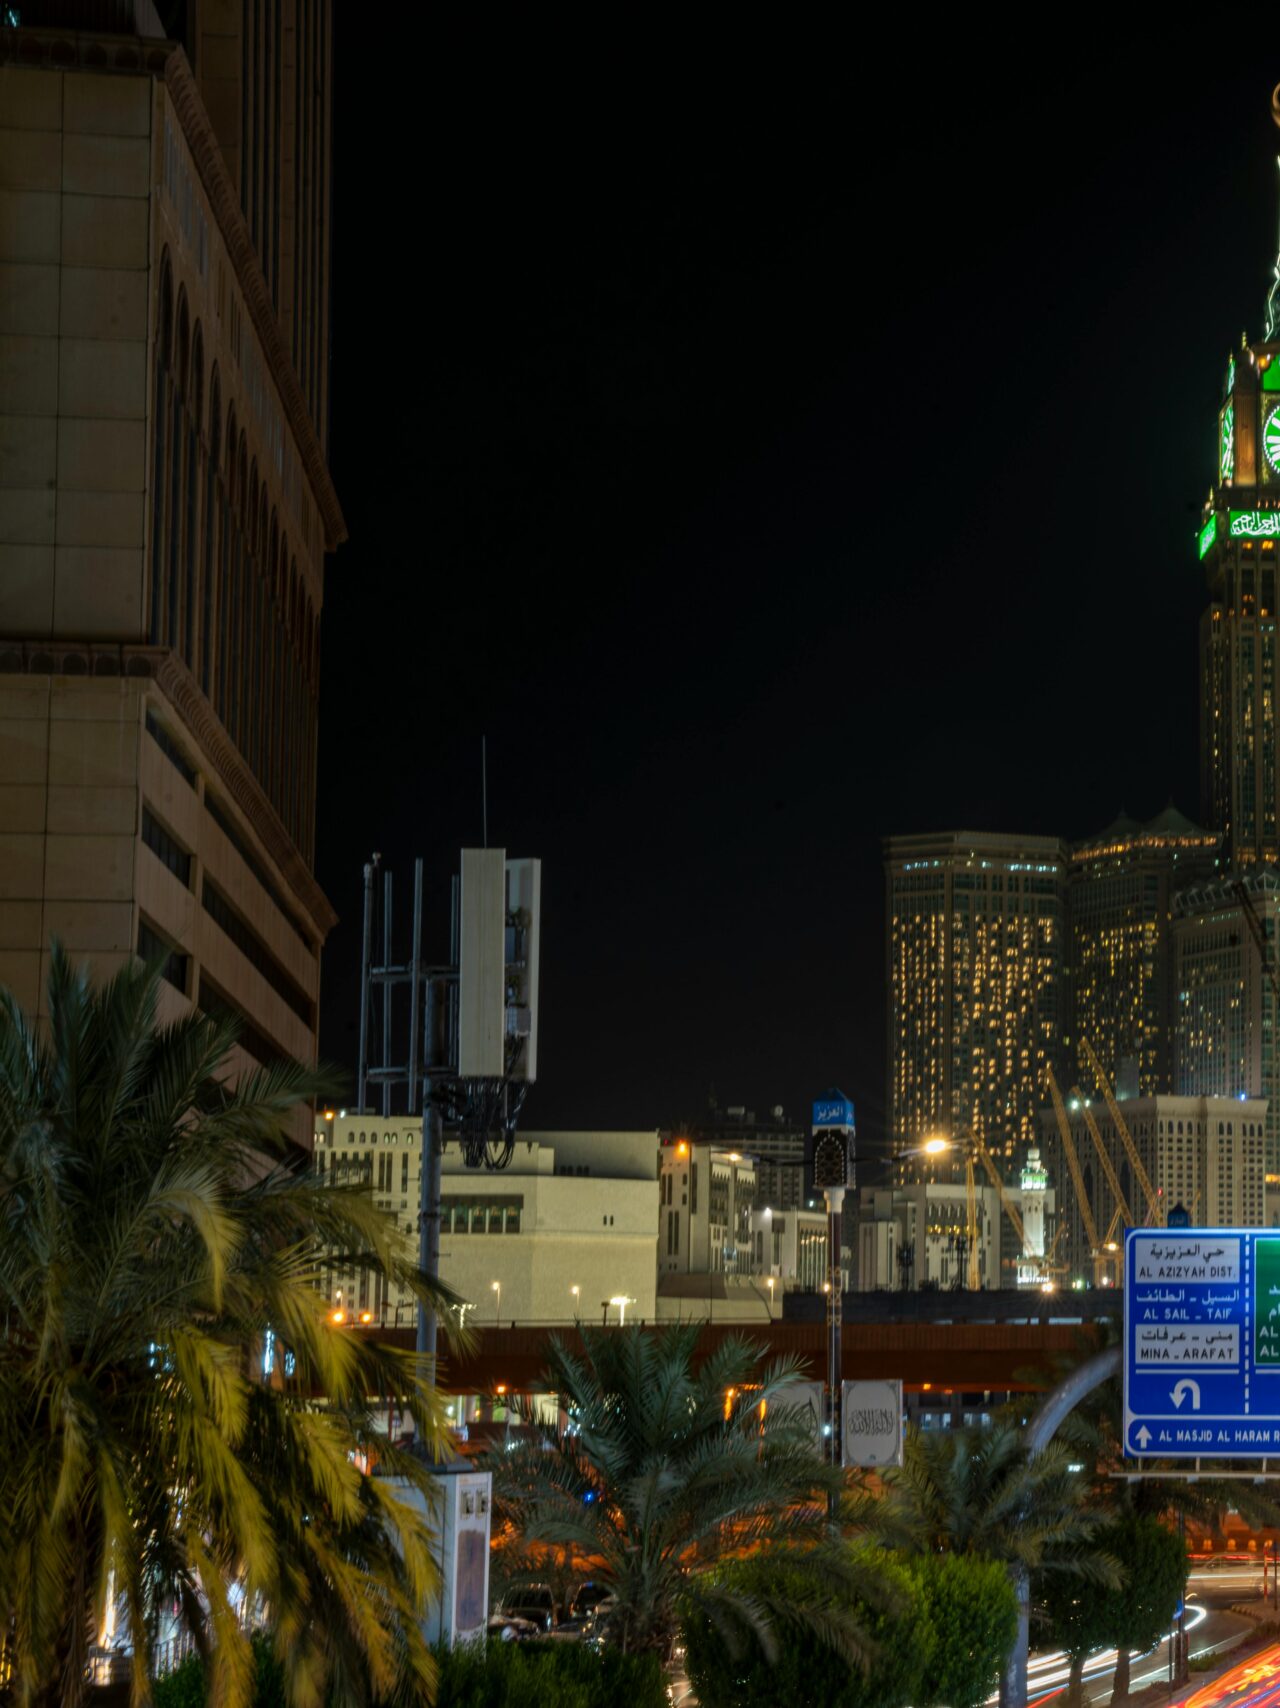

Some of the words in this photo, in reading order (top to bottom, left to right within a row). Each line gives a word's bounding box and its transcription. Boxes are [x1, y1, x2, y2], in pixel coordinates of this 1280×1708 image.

[1150, 1243, 1201, 1260] العزيزية
[1203, 1247, 1225, 1264] حي
[1139, 1266, 1153, 1278] AL
[1158, 1266, 1206, 1278] AZIZYAH
[1210, 1266, 1236, 1278] DIST.
[1136, 1288, 1185, 1303] الطائف
[1201, 1288, 1240, 1306] السيل
[1143, 1307, 1159, 1320] AL
[1164, 1307, 1191, 1320] SAIL
[1207, 1307, 1233, 1320] TAIF
[1141, 1326, 1187, 1345] عرفات
[1205, 1330, 1234, 1345] منى
[1257, 1325, 1279, 1338] AL
[1140, 1348, 1170, 1361] MINA
[1183, 1348, 1235, 1361] ARAFAT
[1258, 1344, 1279, 1358] AL
[1158, 1429, 1172, 1443] AL
[1176, 1429, 1213, 1443] MASJID
[1216, 1429, 1231, 1443] AL
[1235, 1429, 1270, 1443] HARAM
